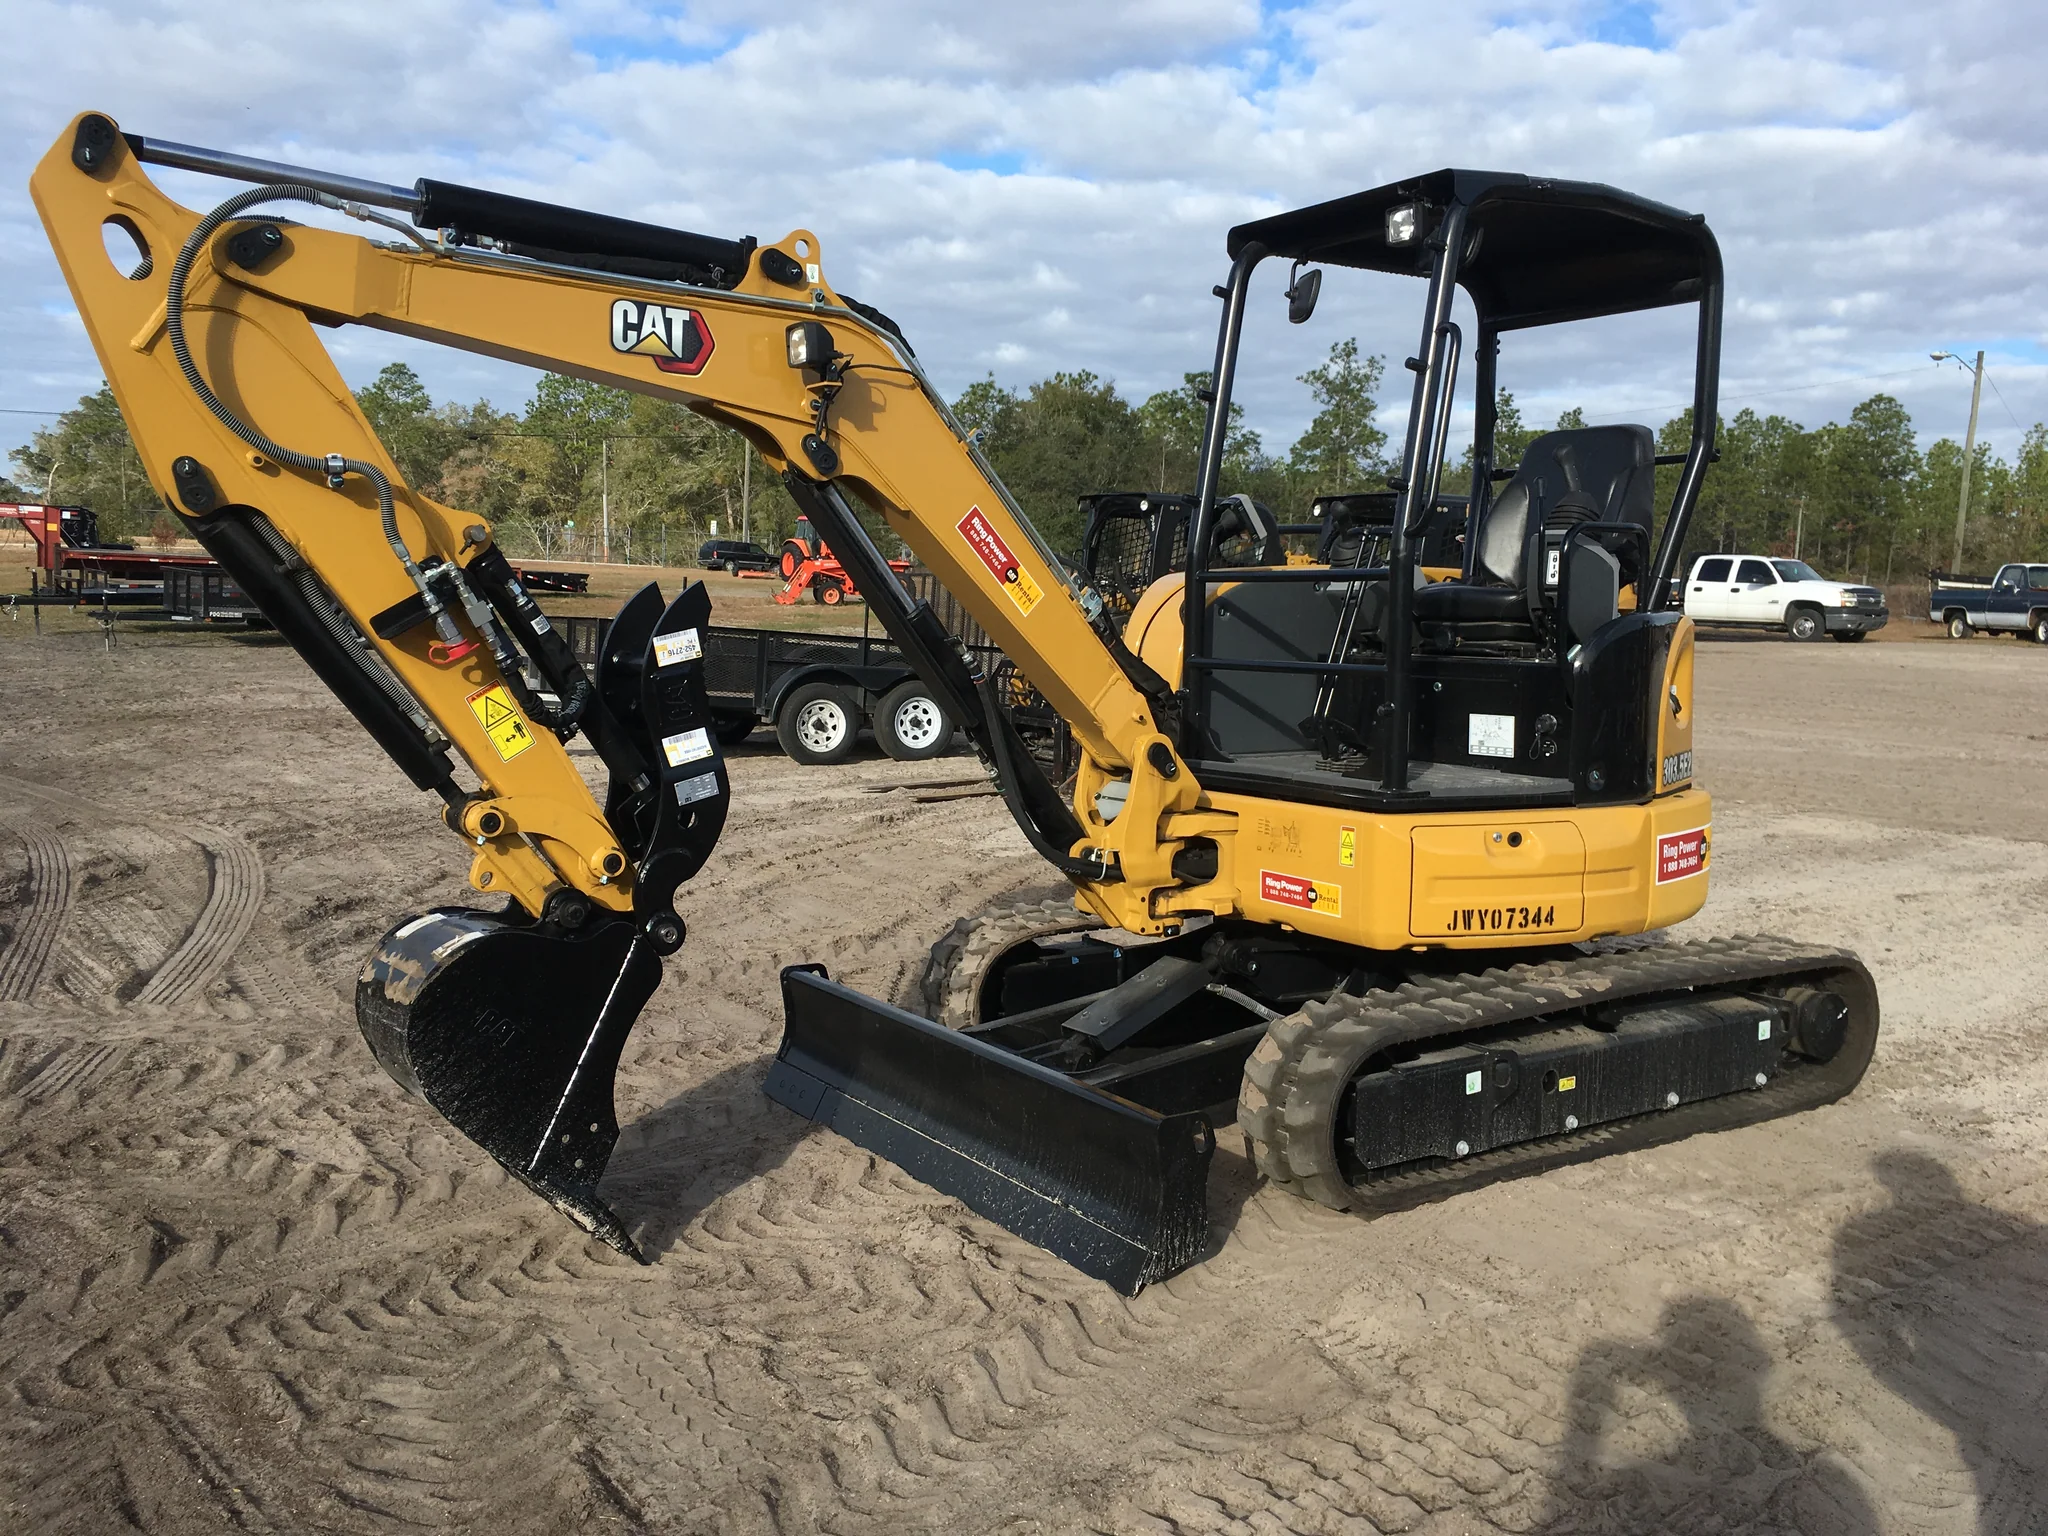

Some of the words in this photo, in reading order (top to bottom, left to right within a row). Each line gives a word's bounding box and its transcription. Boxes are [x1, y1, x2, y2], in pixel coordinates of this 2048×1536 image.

[612, 300, 690, 358] CAT
[969, 530, 980, 542] 888
[971, 516, 987, 539] Ring
[986, 535, 1008, 563] Power
[1006, 569, 1017, 580] CAT
[1015, 581, 1035, 605] Rental
[1663, 751, 1692, 785] 303.5E2
[1663, 844, 1678, 859] Ring
[1679, 840, 1697, 855] Power
[1663, 863, 1667, 873] 1
[1668, 860, 1678, 871] 888
[1265, 877, 1280, 889] Ring
[1281, 880, 1303, 893] Power
[1318, 893, 1339, 904] Rental
[1447, 905, 1554, 931] JWY07344
